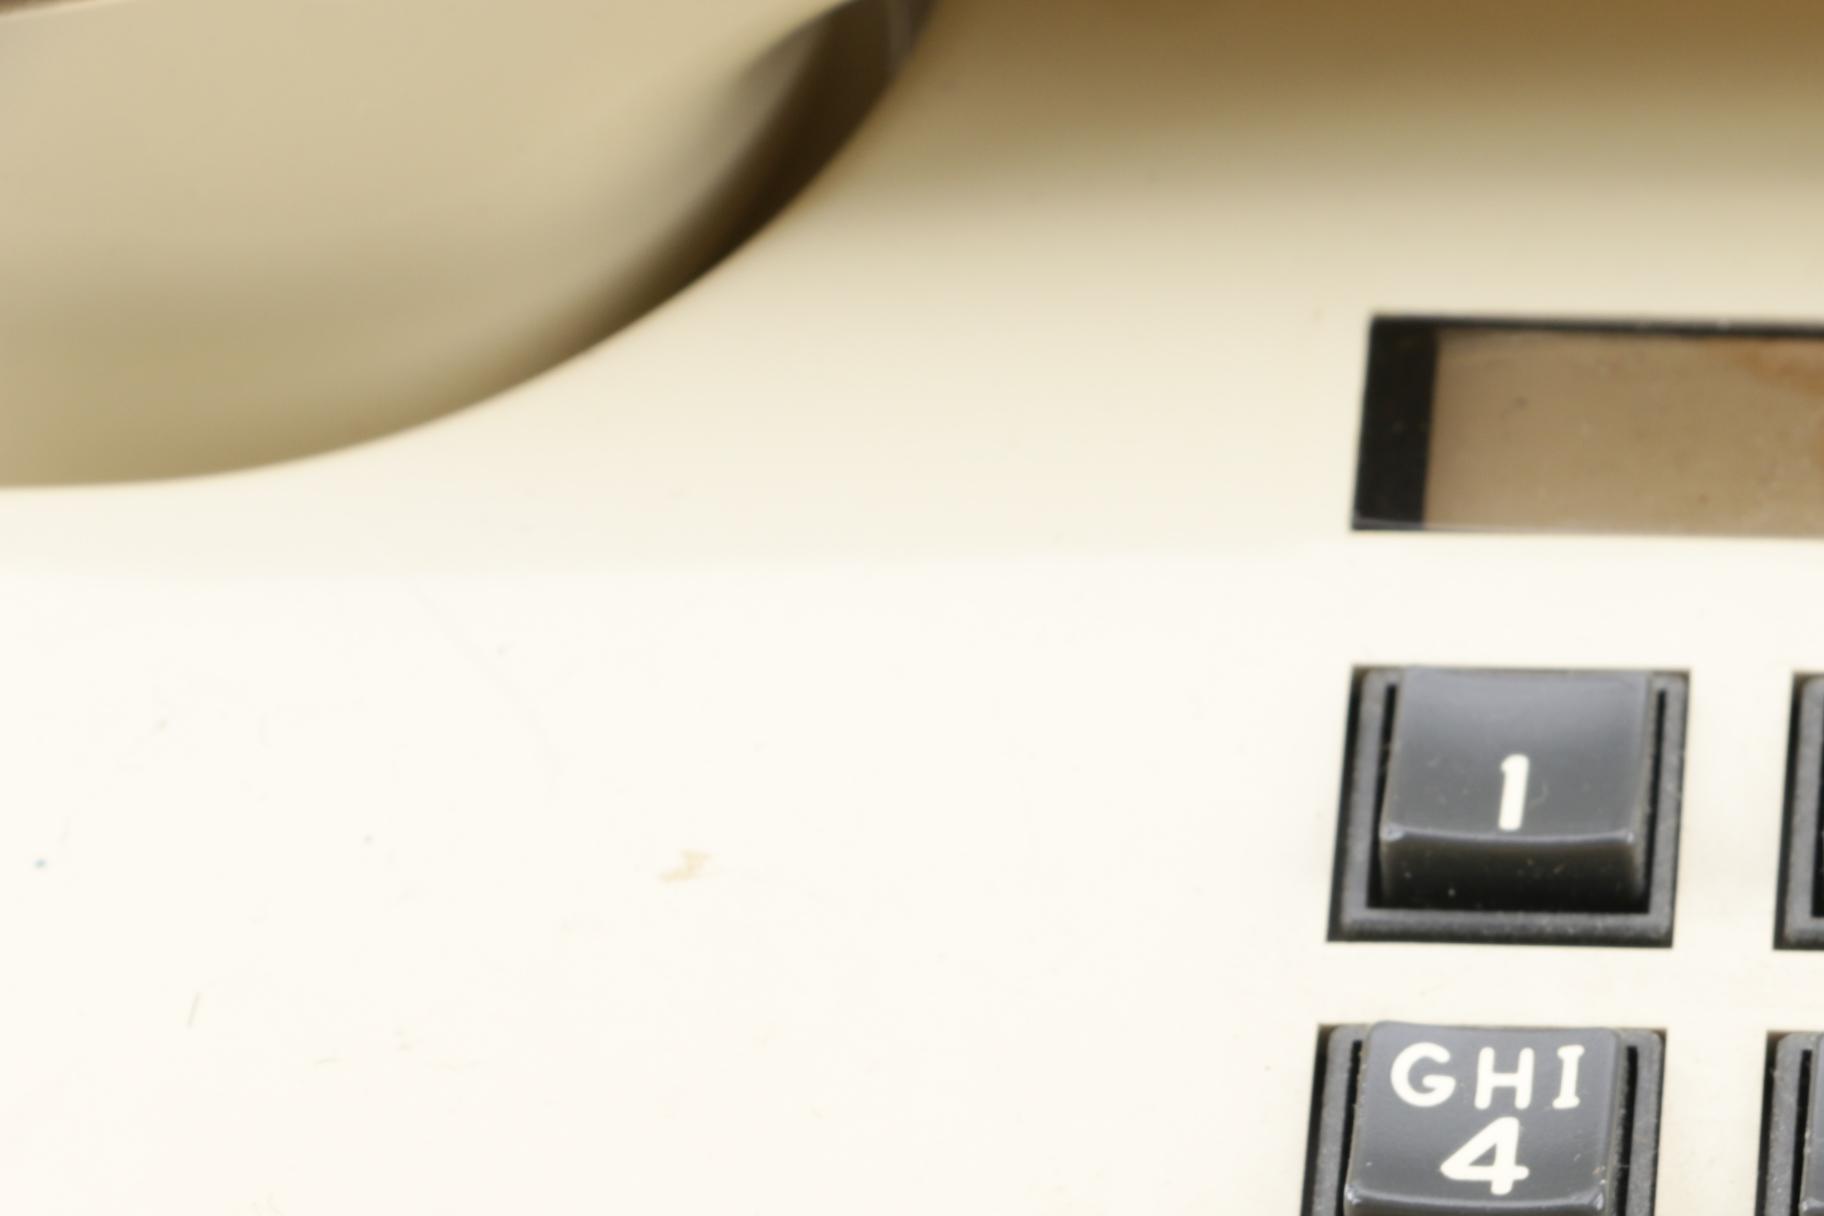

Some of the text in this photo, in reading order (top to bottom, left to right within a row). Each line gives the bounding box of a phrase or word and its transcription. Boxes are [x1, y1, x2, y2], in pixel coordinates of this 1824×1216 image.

[1497, 753, 1531, 833] 1
[1389, 1041, 1585, 1111] GHI
[1439, 1115, 1530, 1197] 4
